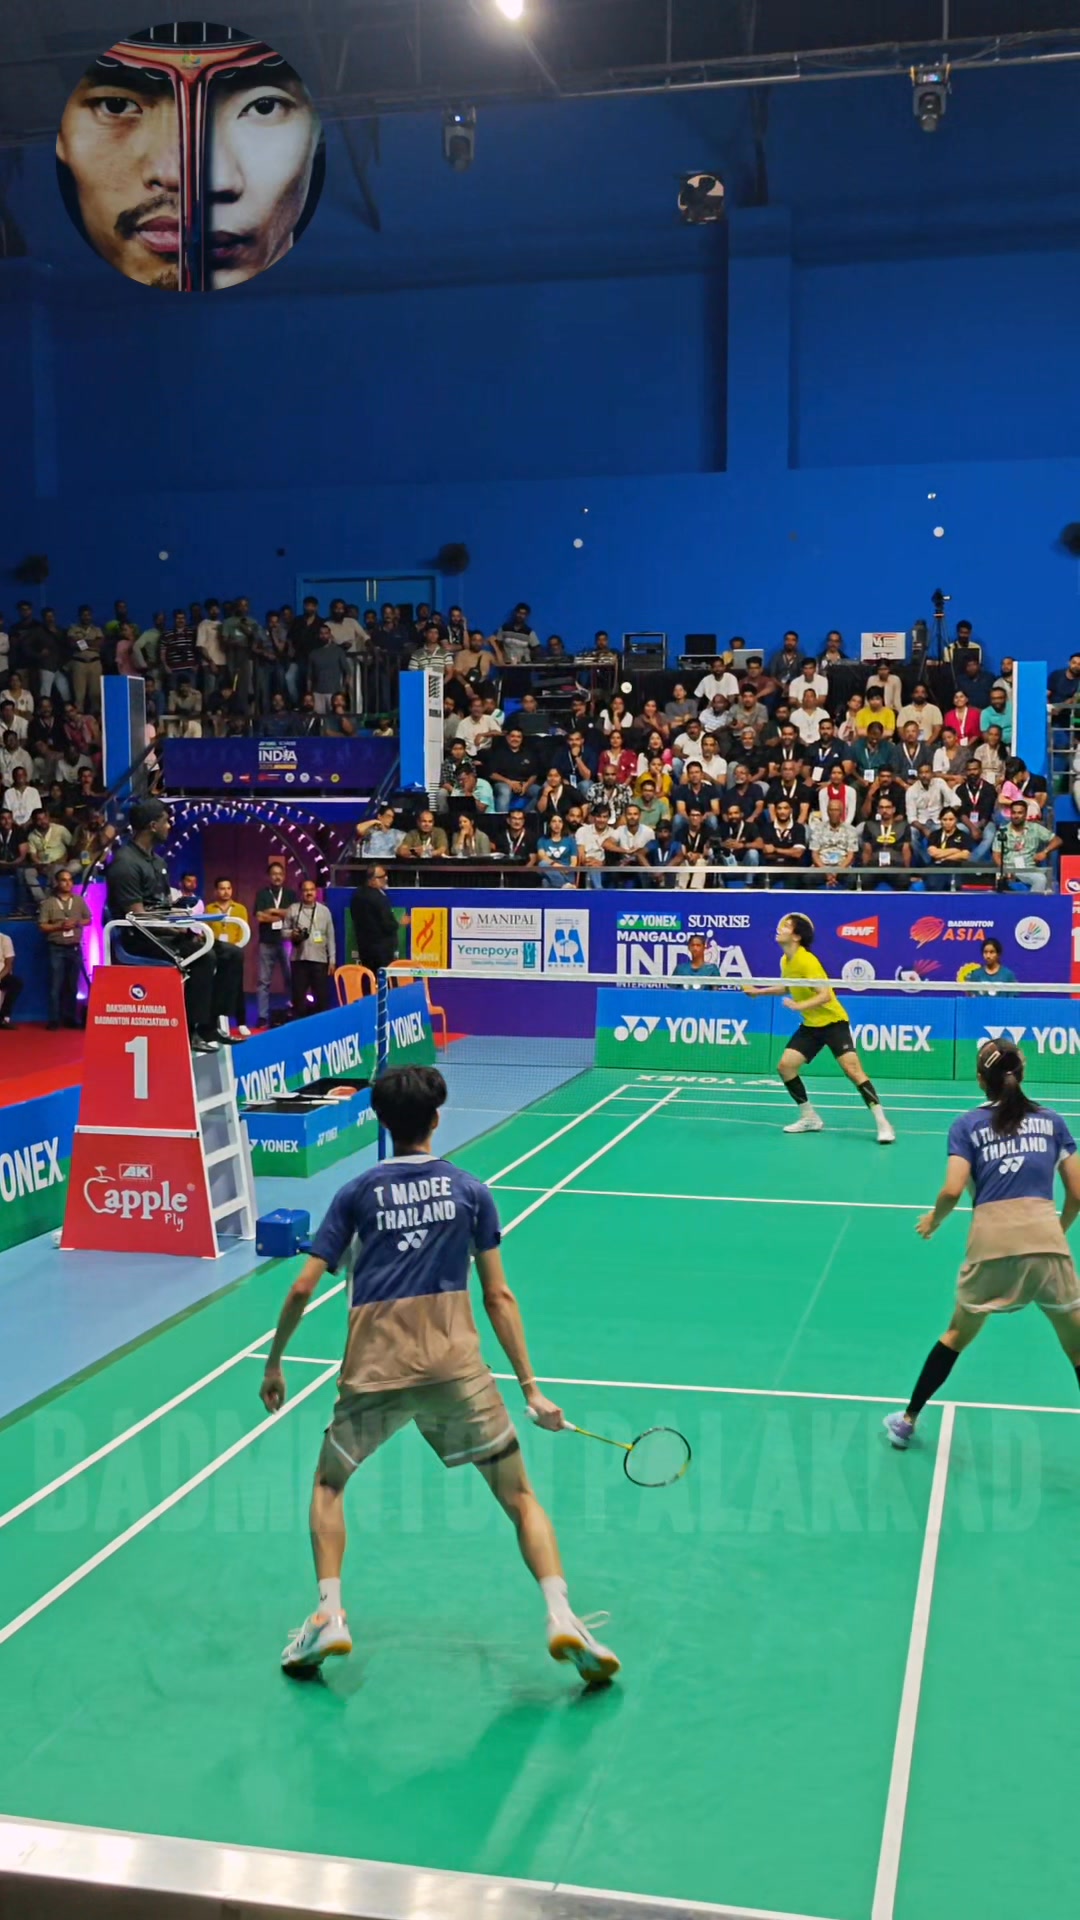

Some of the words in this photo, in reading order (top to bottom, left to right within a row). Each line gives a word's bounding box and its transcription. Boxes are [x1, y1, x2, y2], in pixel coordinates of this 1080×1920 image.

[476, 914, 537, 925] MANIPAL
[642, 915, 676, 927] YONEX
[688, 914, 750, 928] SUNRISE
[947, 919, 994, 928] BADMINTON
[616, 930, 705, 943] MANGALO
[841, 925, 875, 937] BWF
[943, 928, 985, 941] ASIA
[457, 944, 519, 959] Yenepoya
[391, 1011, 425, 1048] YONEX
[666, 1017, 748, 1045] YONEX
[849, 1024, 932, 1052] YONEX
[324, 1033, 363, 1076] YONEX
[125, 1036, 148, 1099] 1
[240, 1061, 289, 1101] YONEX
[637, 1075, 737, 1085] YONEX
[260, 1139, 299, 1153] YONEX
[981, 1137, 1048, 1162] THAILAND
[104, 1180, 188, 1220] apple
[374, 1186, 385, 1207] T
[391, 1176, 453, 1206] MADEE
[164, 1213, 184, 1232] Ply
[376, 1200, 457, 1231] THAILAND
